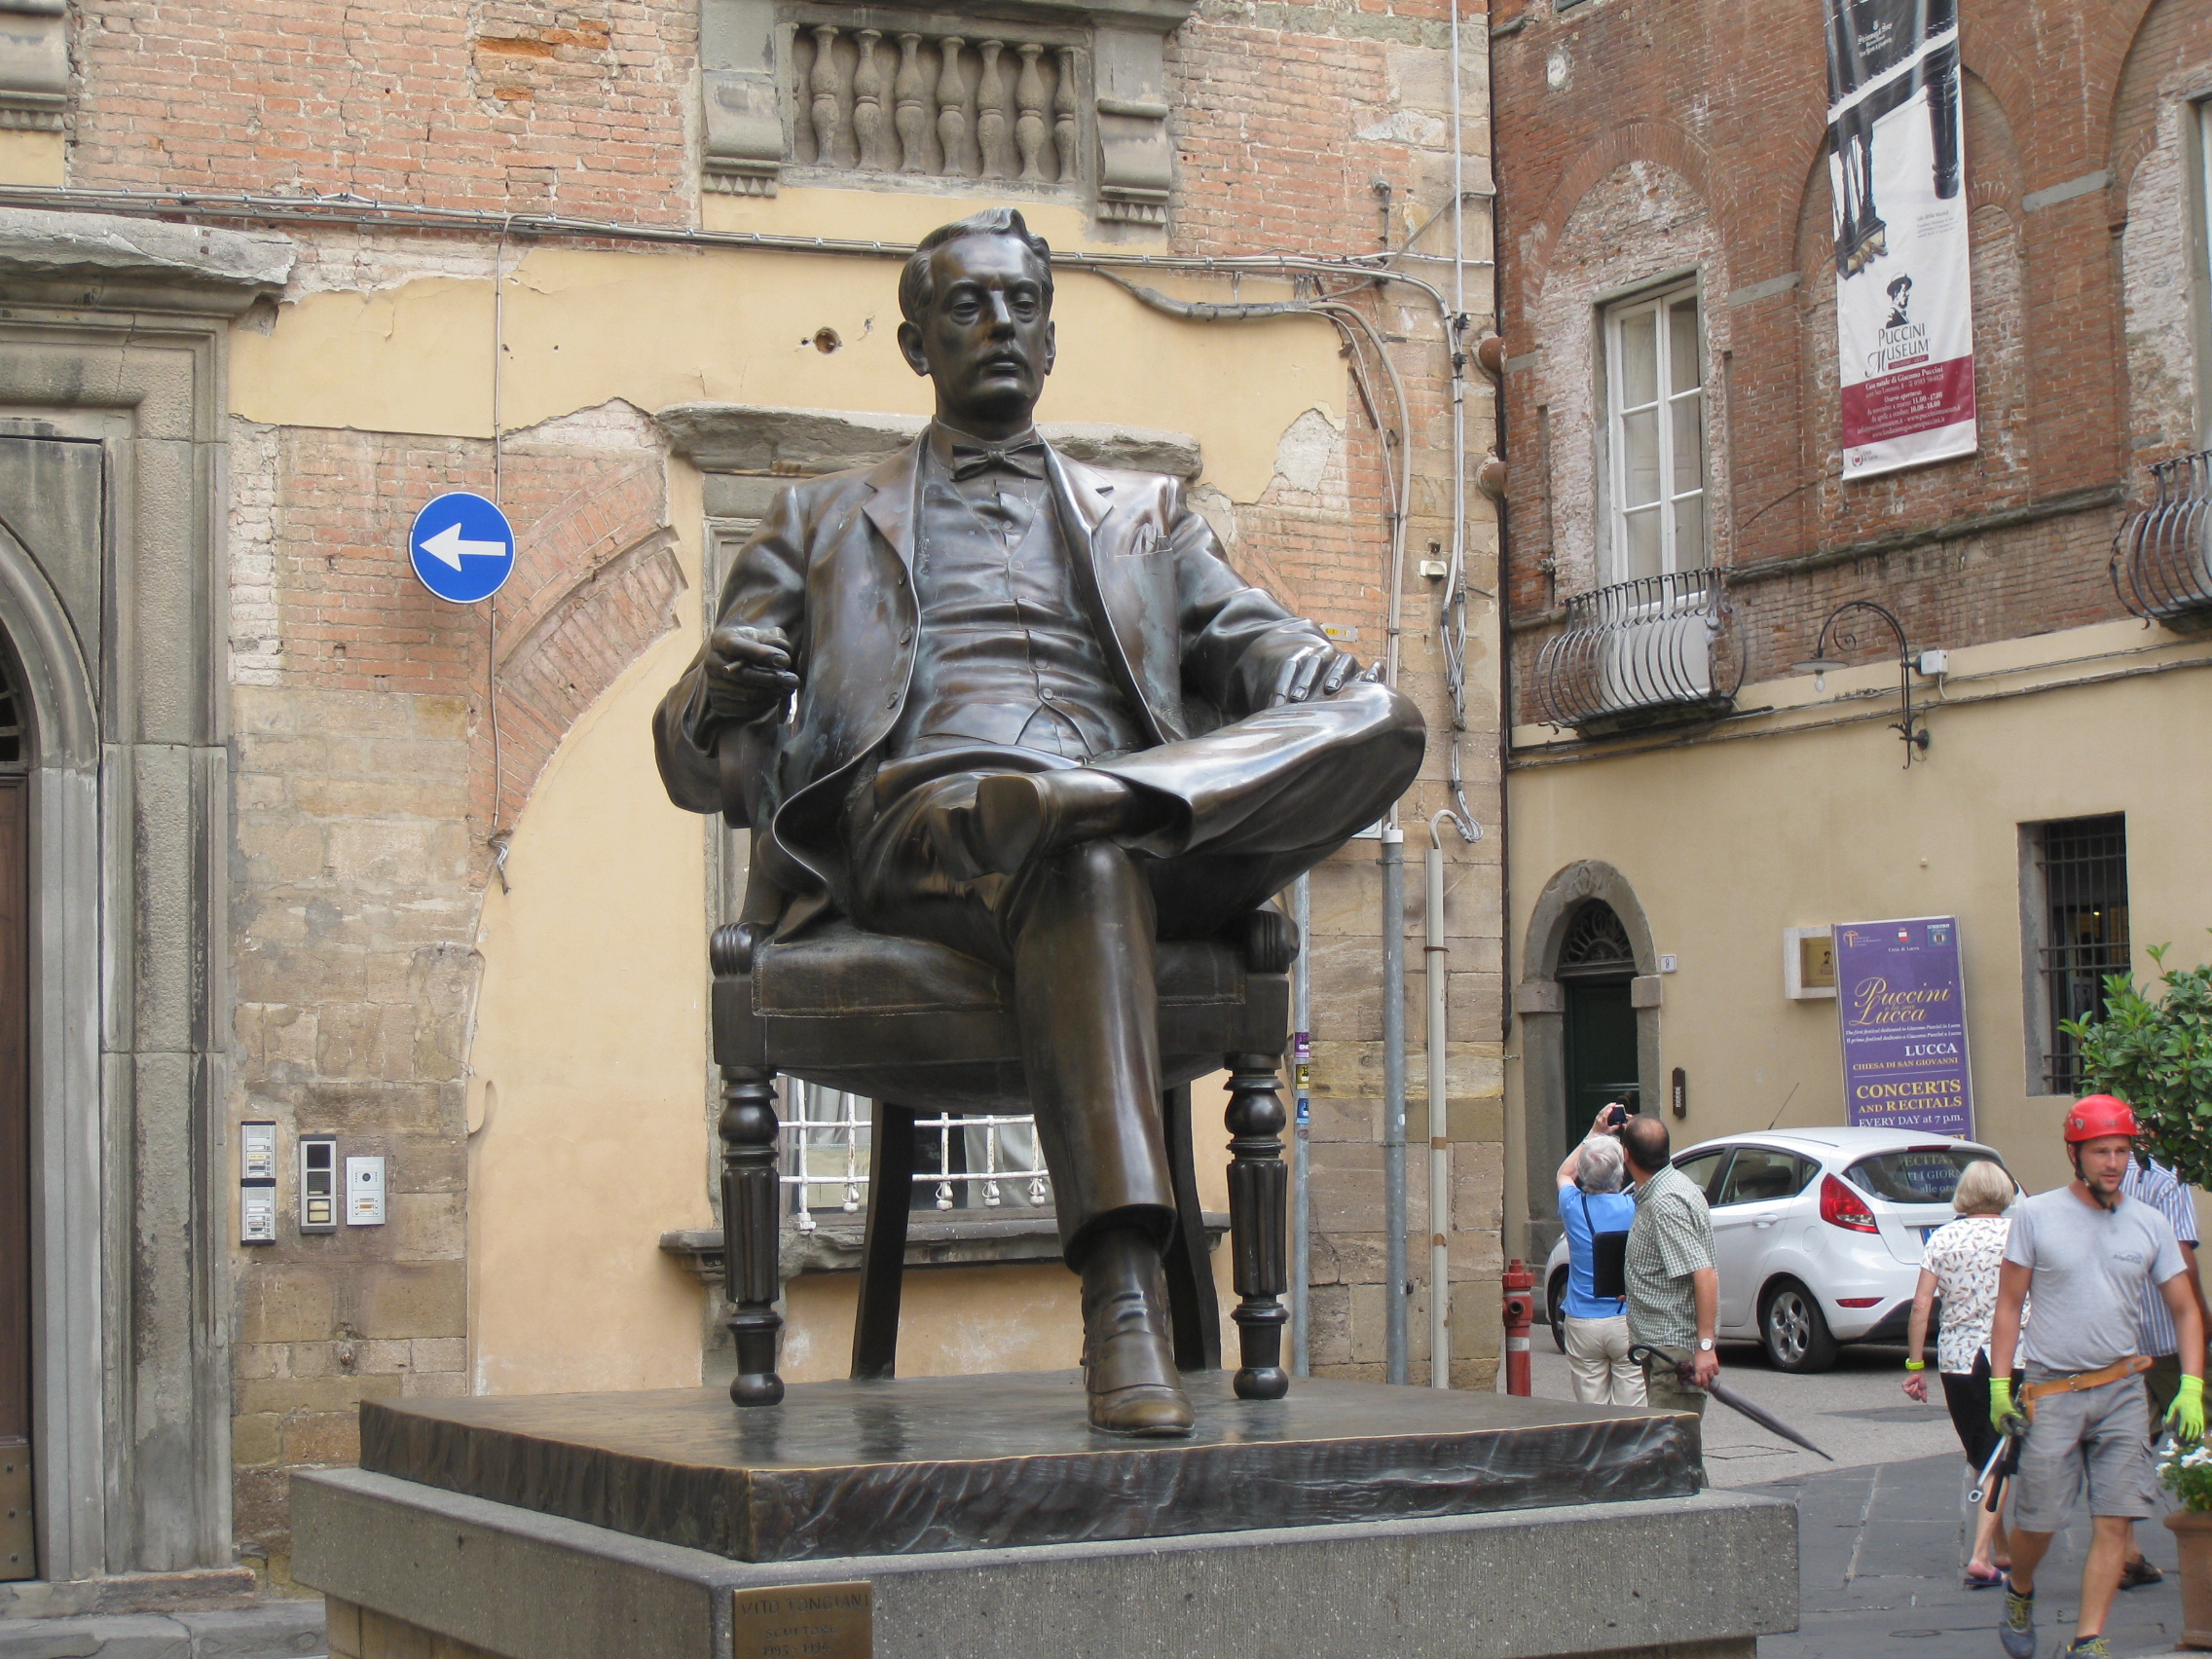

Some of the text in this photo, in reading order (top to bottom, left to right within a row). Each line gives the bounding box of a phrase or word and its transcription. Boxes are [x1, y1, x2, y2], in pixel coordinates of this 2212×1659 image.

[1876, 377, 1890, 387] natale
[1891, 375, 1898, 384] di
[1898, 372, 1921, 382] Giacomo
[1922, 365, 1943, 377] Puccini
[1912, 395, 1927, 404] 11.00
[1930, 391, 1943, 400] 17.00
[1910, 404, 1925, 413] 10.00
[1927, 400, 1941, 409] 18.00
[1855, 977, 1952, 1008] Puccini
[1849, 995, 1927, 1026] Lucca
[1905, 1042, 1958, 1056] LUCCA
[1853, 1062, 1885, 1071] CHIESA
[1897, 1059, 1914, 1068] SAN
[1915, 1057, 1959, 1066] GIOVANNI
[1857, 1079, 1962, 1099] CONCERTS
[1859, 1096, 1963, 1113] AND RECITALS
[1859, 1114, 1964, 1127] EVERY DAY at 7 p.m.
[1905, 1154, 1953, 1166] ECITA
[741, 1594, 868, 1615] VITO TONGIANI
[766, 1624, 837, 1639] SCULTORE
